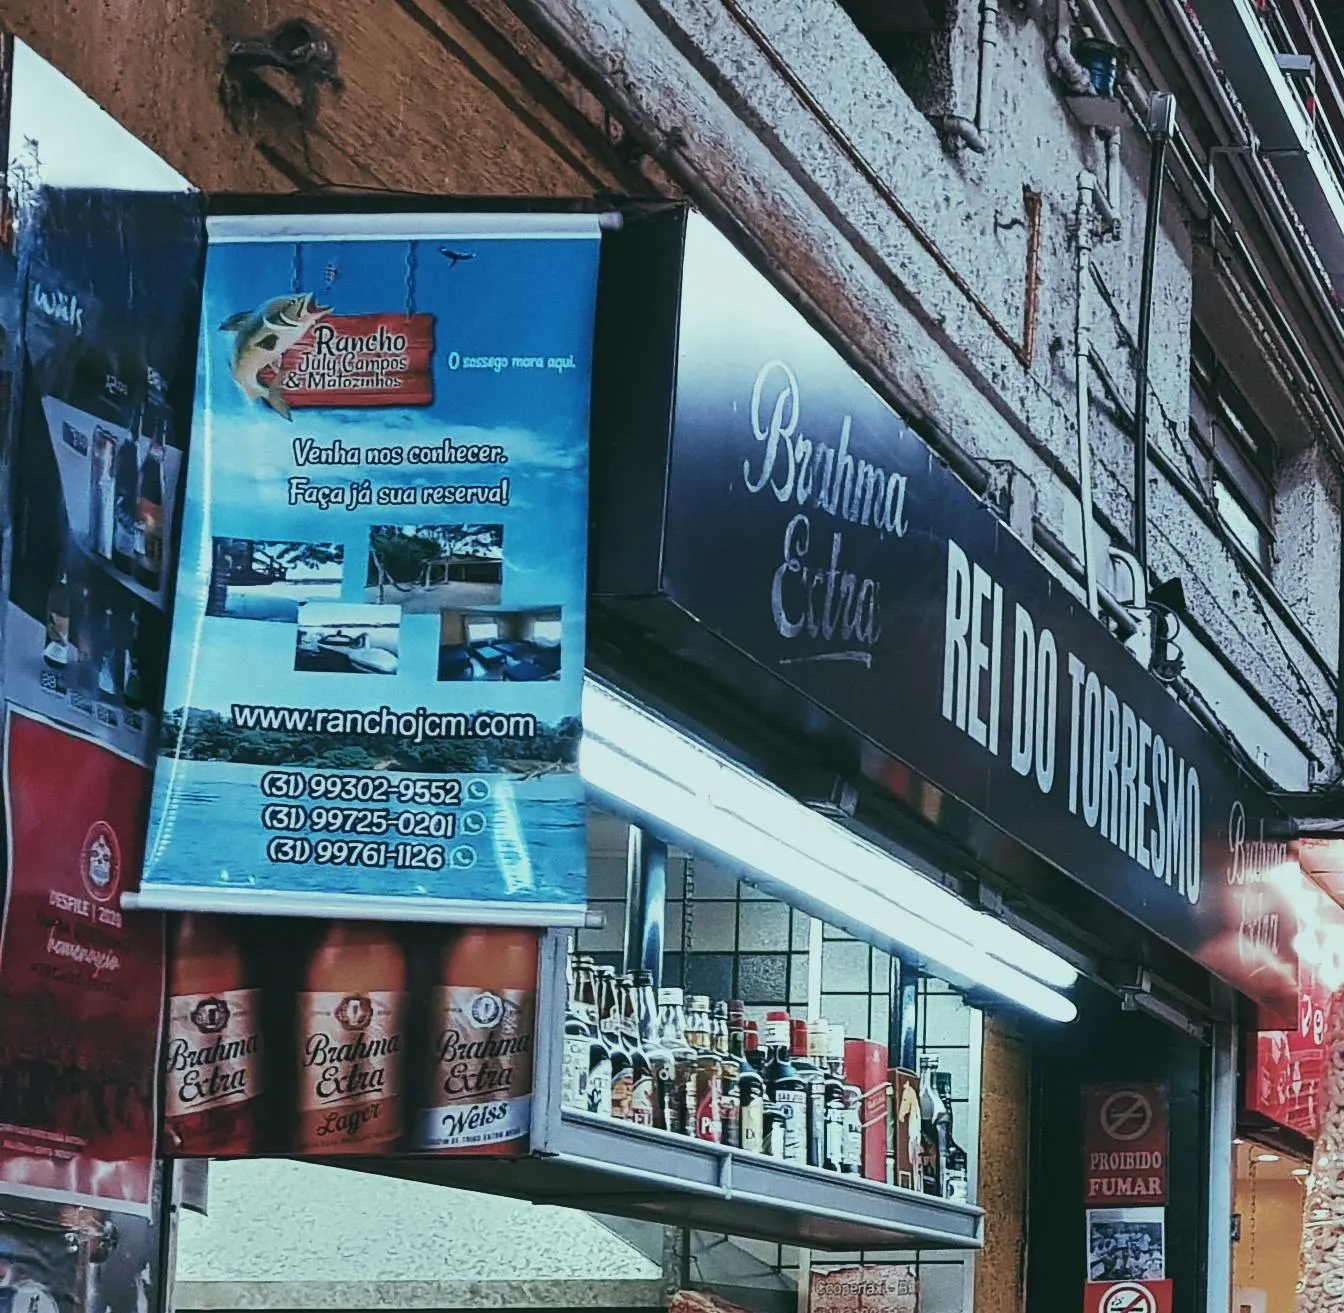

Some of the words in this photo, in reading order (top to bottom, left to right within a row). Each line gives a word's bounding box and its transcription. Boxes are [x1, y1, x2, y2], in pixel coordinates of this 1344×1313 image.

[313, 324, 407, 356] Rancho
[299, 352, 336, 375] July
[342, 352, 408, 375] Campos
[448, 351, 460, 370] O
[284, 372, 300, 388] &
[307, 373, 402, 388] Matozinhos
[293, 438, 360, 465] Venha
[366, 447, 403, 464] nos
[407, 438, 508, 464] conhecer.
[744, 360, 908, 537] Brahma
[288, 477, 344, 509] Faça
[347, 480, 372, 510] já
[377, 487, 416, 504] sua
[422, 477, 509, 505] reserva!
[771, 513, 881, 645] Extra
[232, 704, 535, 742] www.ranchojcm.com
[942, 538, 1003, 756] REI
[1011, 602, 1058, 793] DO
[1068, 652, 1200, 905] TORRESMO
[263, 772, 305, 797] (31)
[309, 775, 461, 805] 99302-9552
[263, 806, 305, 830] (31)
[309, 808, 455, 838] 99725-0201
[269, 838, 310, 862] (31)
[315, 841, 443, 870] 99761-1126
[166, 1033, 259, 1072] Brahma
[303, 1033, 400, 1068] Brahma
[436, 1029, 529, 1064] Brahma
[178, 1067, 246, 1102] Extra
[315, 1066, 385, 1099] Extra
[444, 1065, 514, 1097] Extra
[316, 1104, 382, 1136] Lager
[441, 1102, 508, 1137] Weiss
[1089, 1151, 1162, 1170] PROIBIDO
[1087, 1177, 1163, 1196] FUMAR
